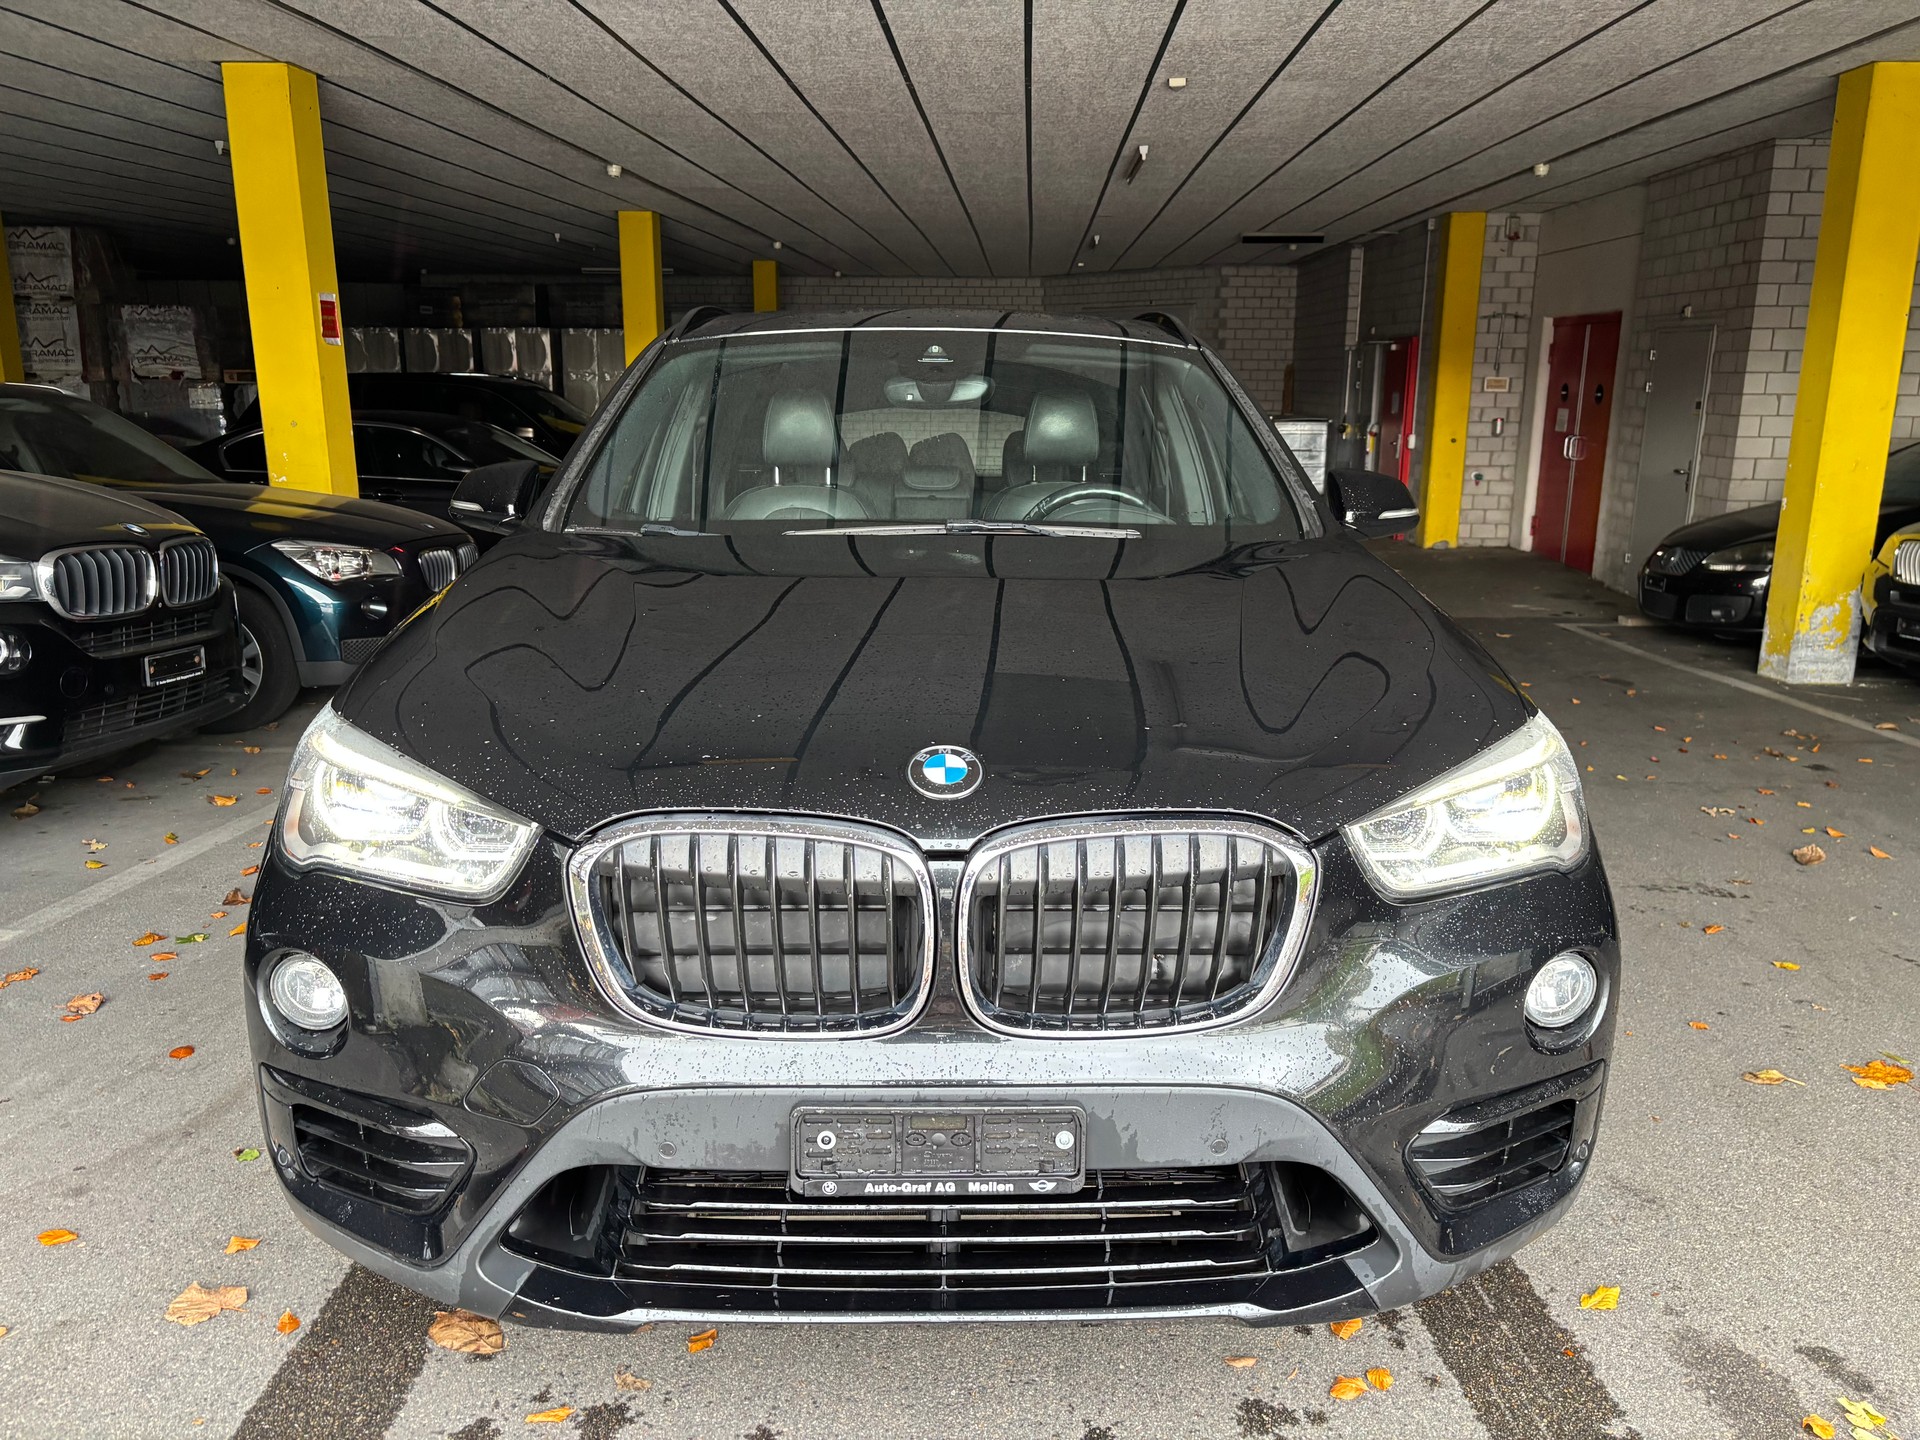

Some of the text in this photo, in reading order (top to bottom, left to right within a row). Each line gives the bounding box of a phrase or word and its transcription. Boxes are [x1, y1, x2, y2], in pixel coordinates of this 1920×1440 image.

[915, 748, 975, 762] BMW
[864, 1182, 932, 1193] Auto-Graf
[934, 1182, 956, 1192] AG
